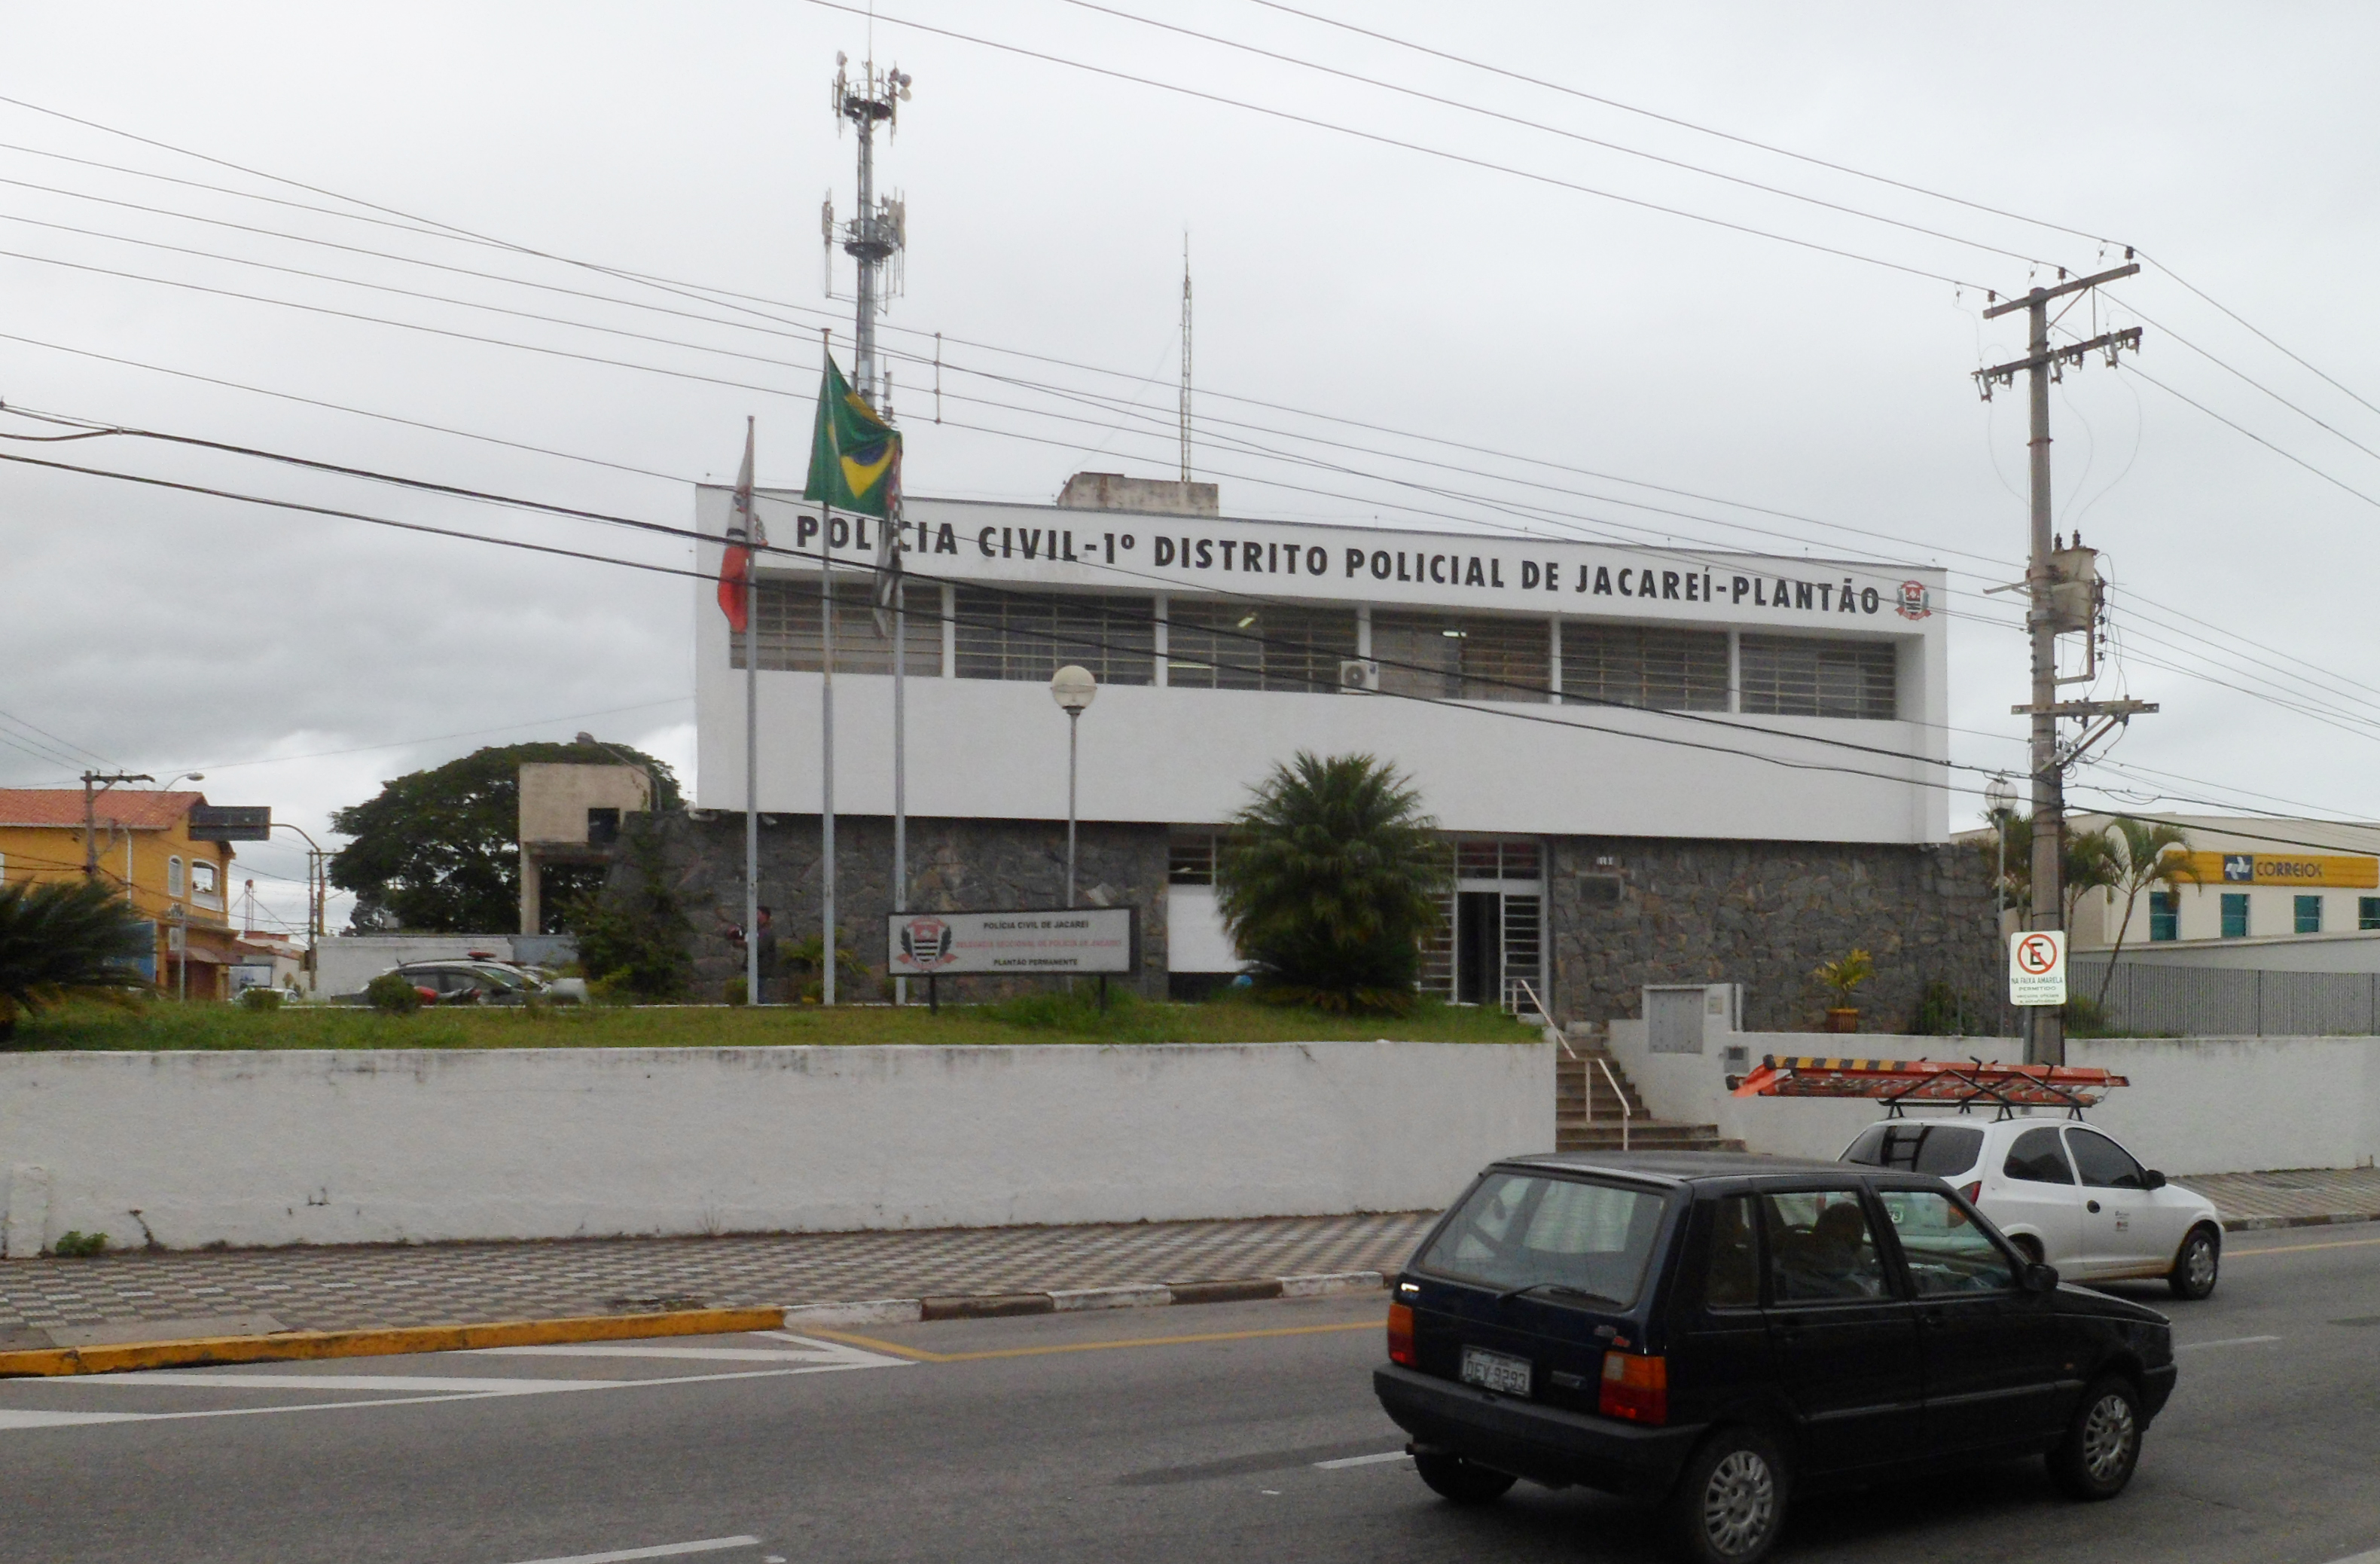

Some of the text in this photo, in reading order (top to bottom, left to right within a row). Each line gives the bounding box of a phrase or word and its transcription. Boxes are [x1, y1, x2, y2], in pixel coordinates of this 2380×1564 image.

[1155, 536, 1328, 576] DISTRITO
[1345, 548, 1505, 588] POLICIAL
[1521, 560, 1559, 591] DE
[2030, 942, 2043, 966] E
